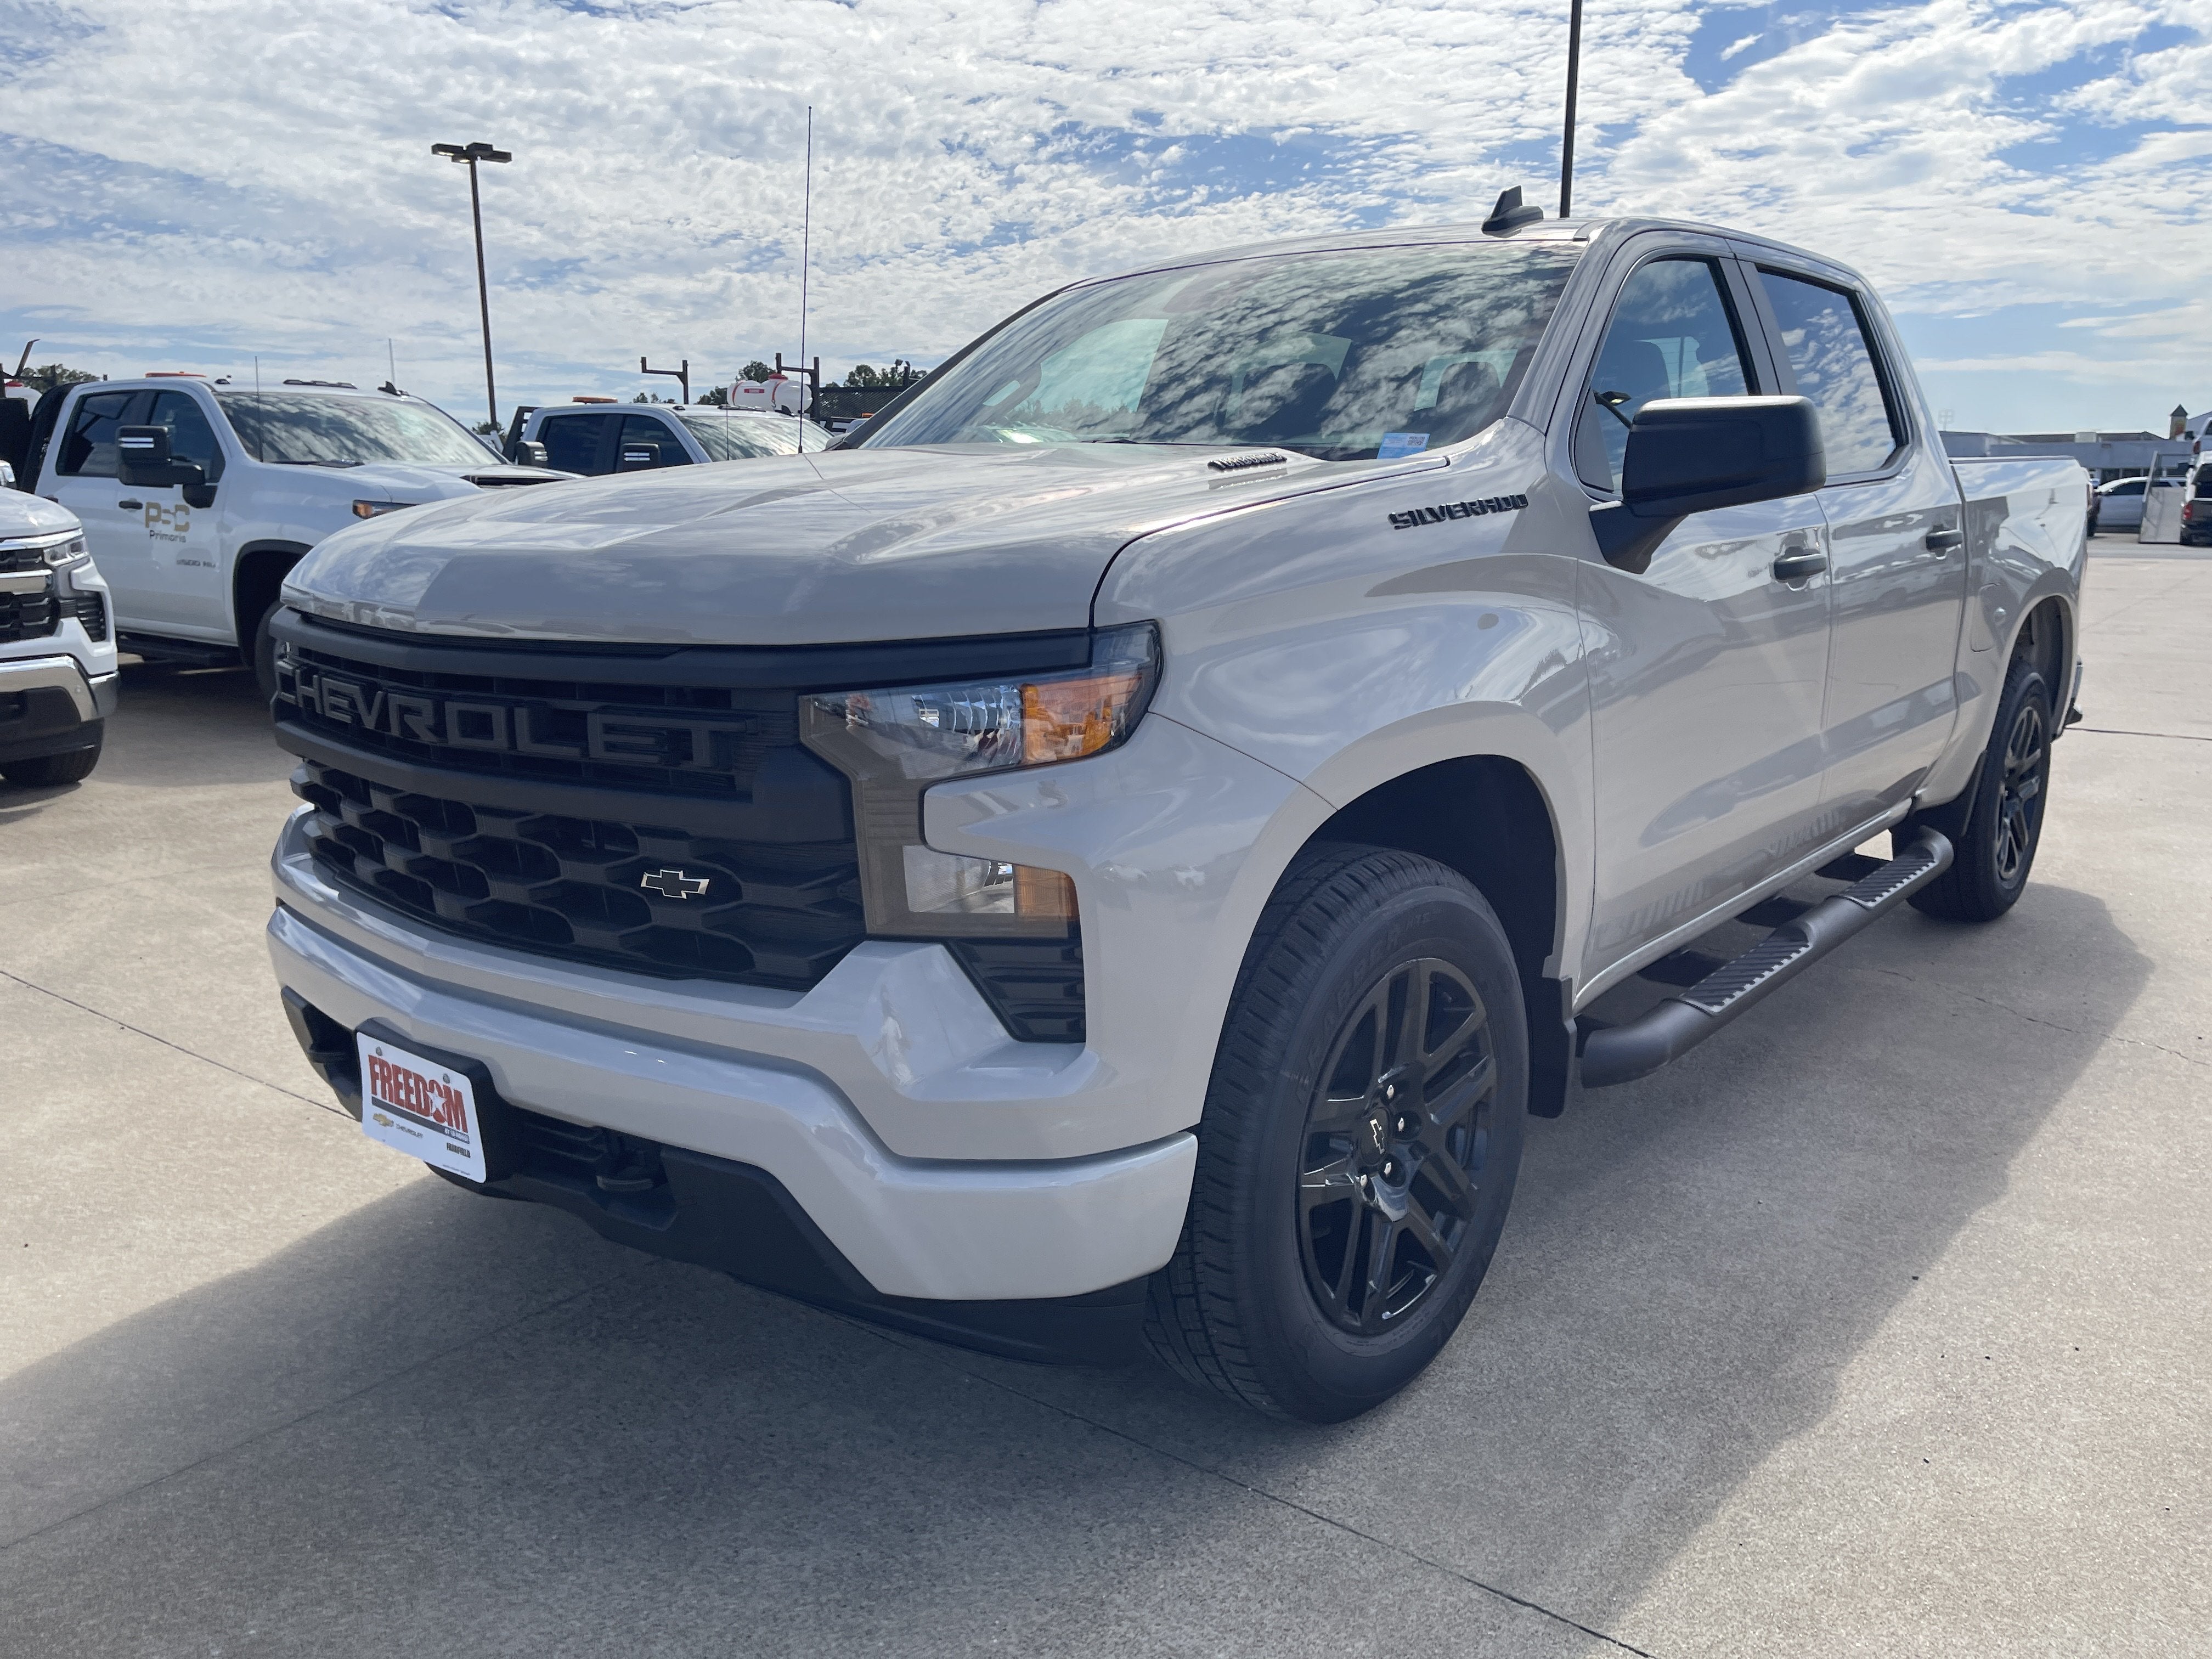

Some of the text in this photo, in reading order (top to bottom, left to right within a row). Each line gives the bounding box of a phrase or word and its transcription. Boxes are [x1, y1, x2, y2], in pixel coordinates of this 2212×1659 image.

[1388, 494, 1529, 530] SILVERADO
[275, 660, 758, 766] CHEVROLET
[368, 1054, 468, 1133] FREEDOM
